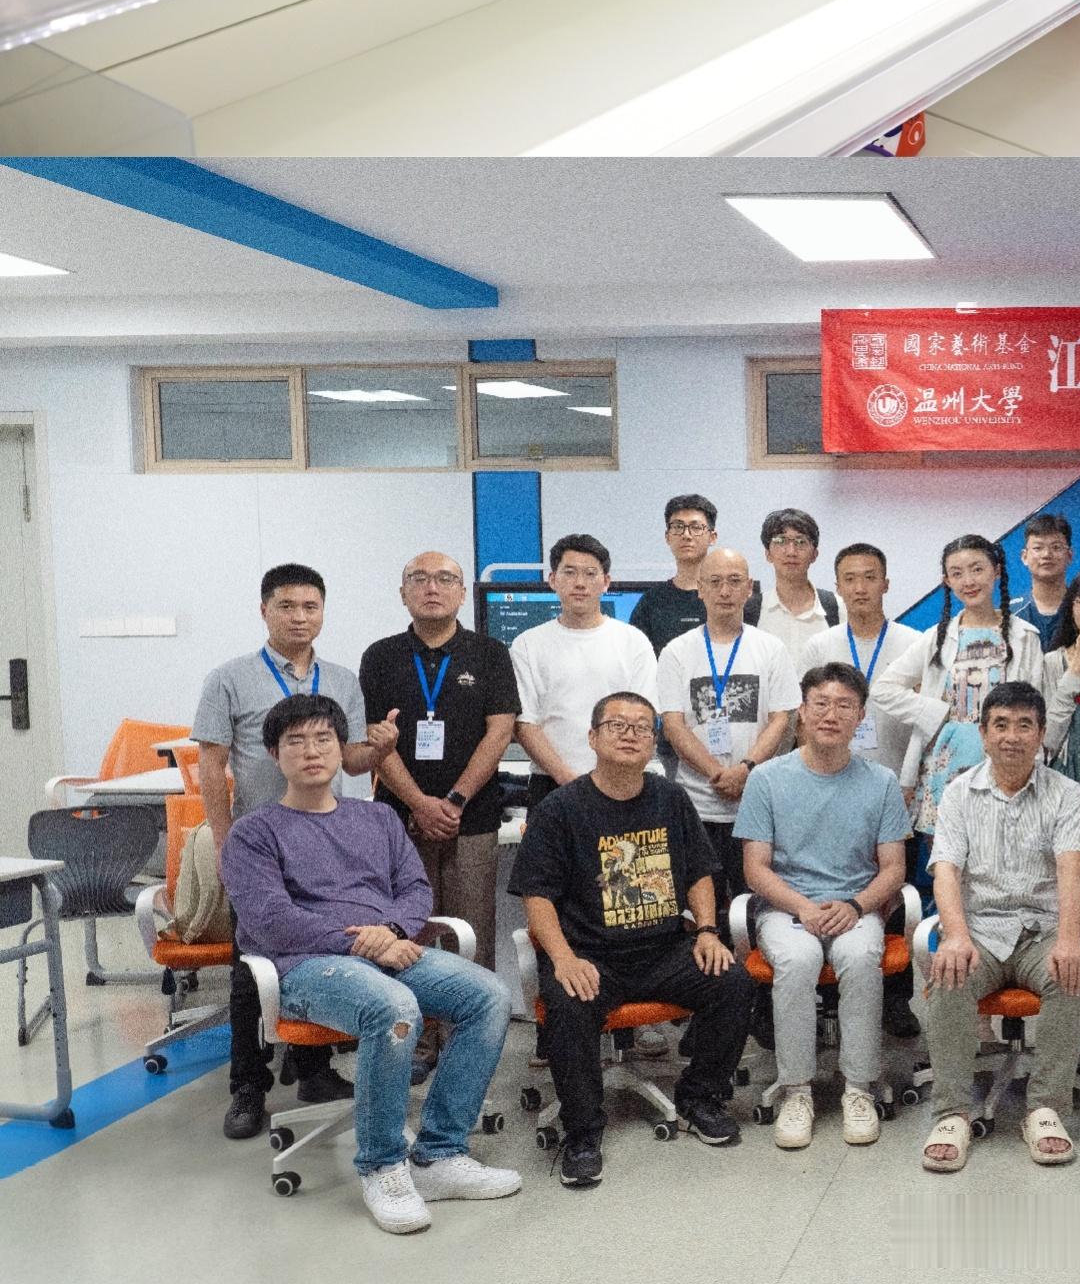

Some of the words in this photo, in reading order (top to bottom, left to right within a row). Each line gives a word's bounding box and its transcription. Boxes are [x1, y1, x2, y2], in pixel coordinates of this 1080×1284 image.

[904, 331, 1038, 357] 國家藝術基金
[912, 386, 1024, 417] 温州大學
[912, 416, 961, 426] WENZHOU
[965, 416, 1023, 425] UNIVERSITY
